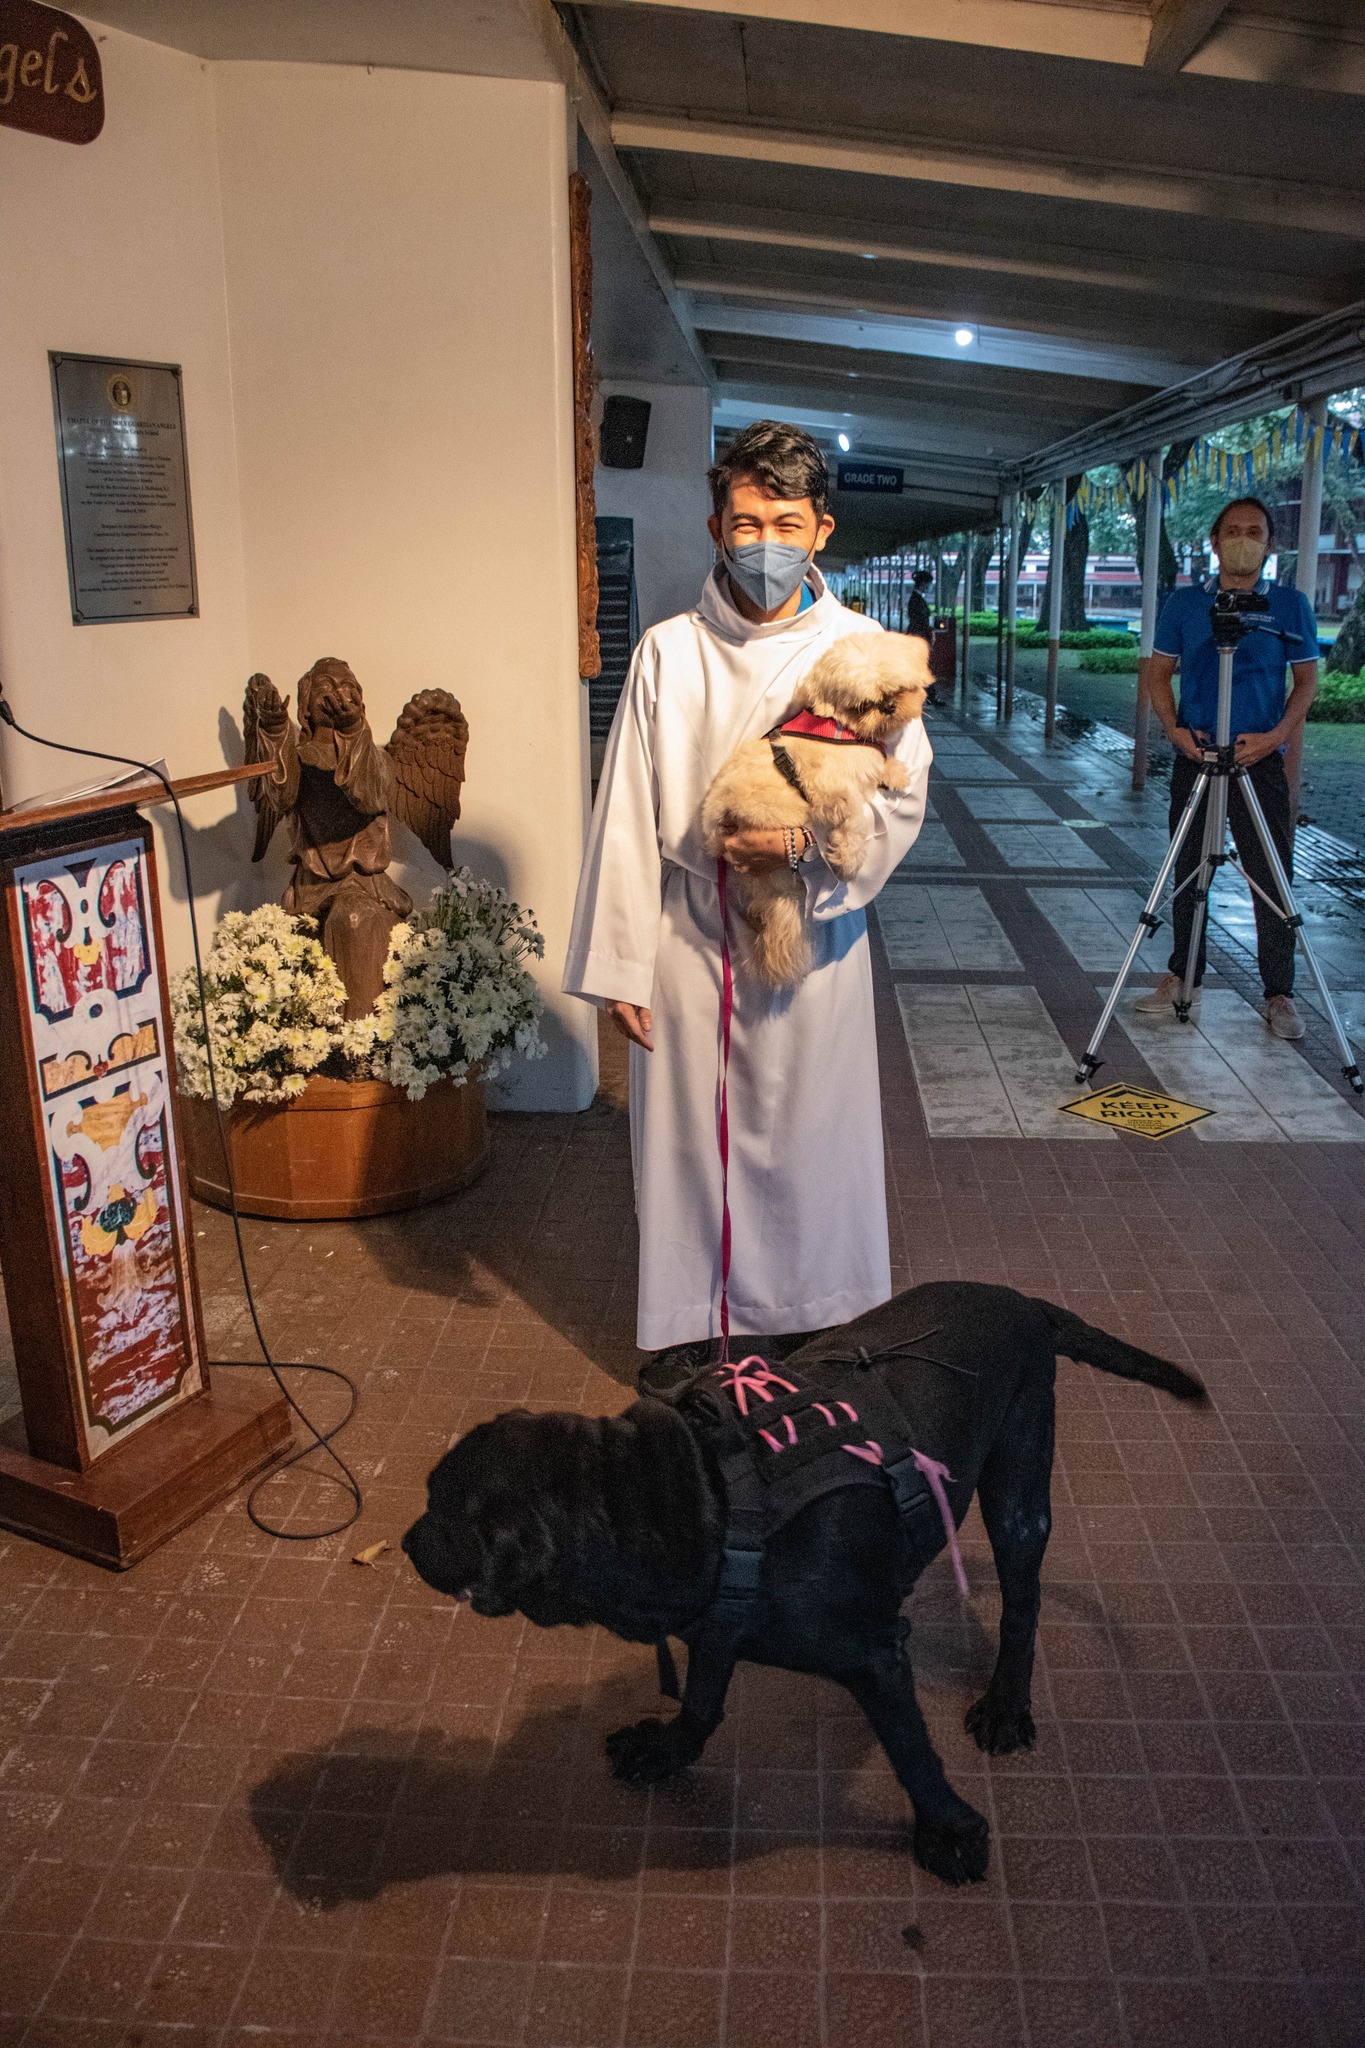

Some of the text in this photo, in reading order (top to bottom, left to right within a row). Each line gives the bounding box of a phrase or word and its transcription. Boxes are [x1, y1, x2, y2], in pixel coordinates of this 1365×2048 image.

[844, 472, 898, 486] GRADE TWO
[1100, 1101, 1170, 1110] KEEP
[1100, 1110, 1180, 1119] RIGHT
